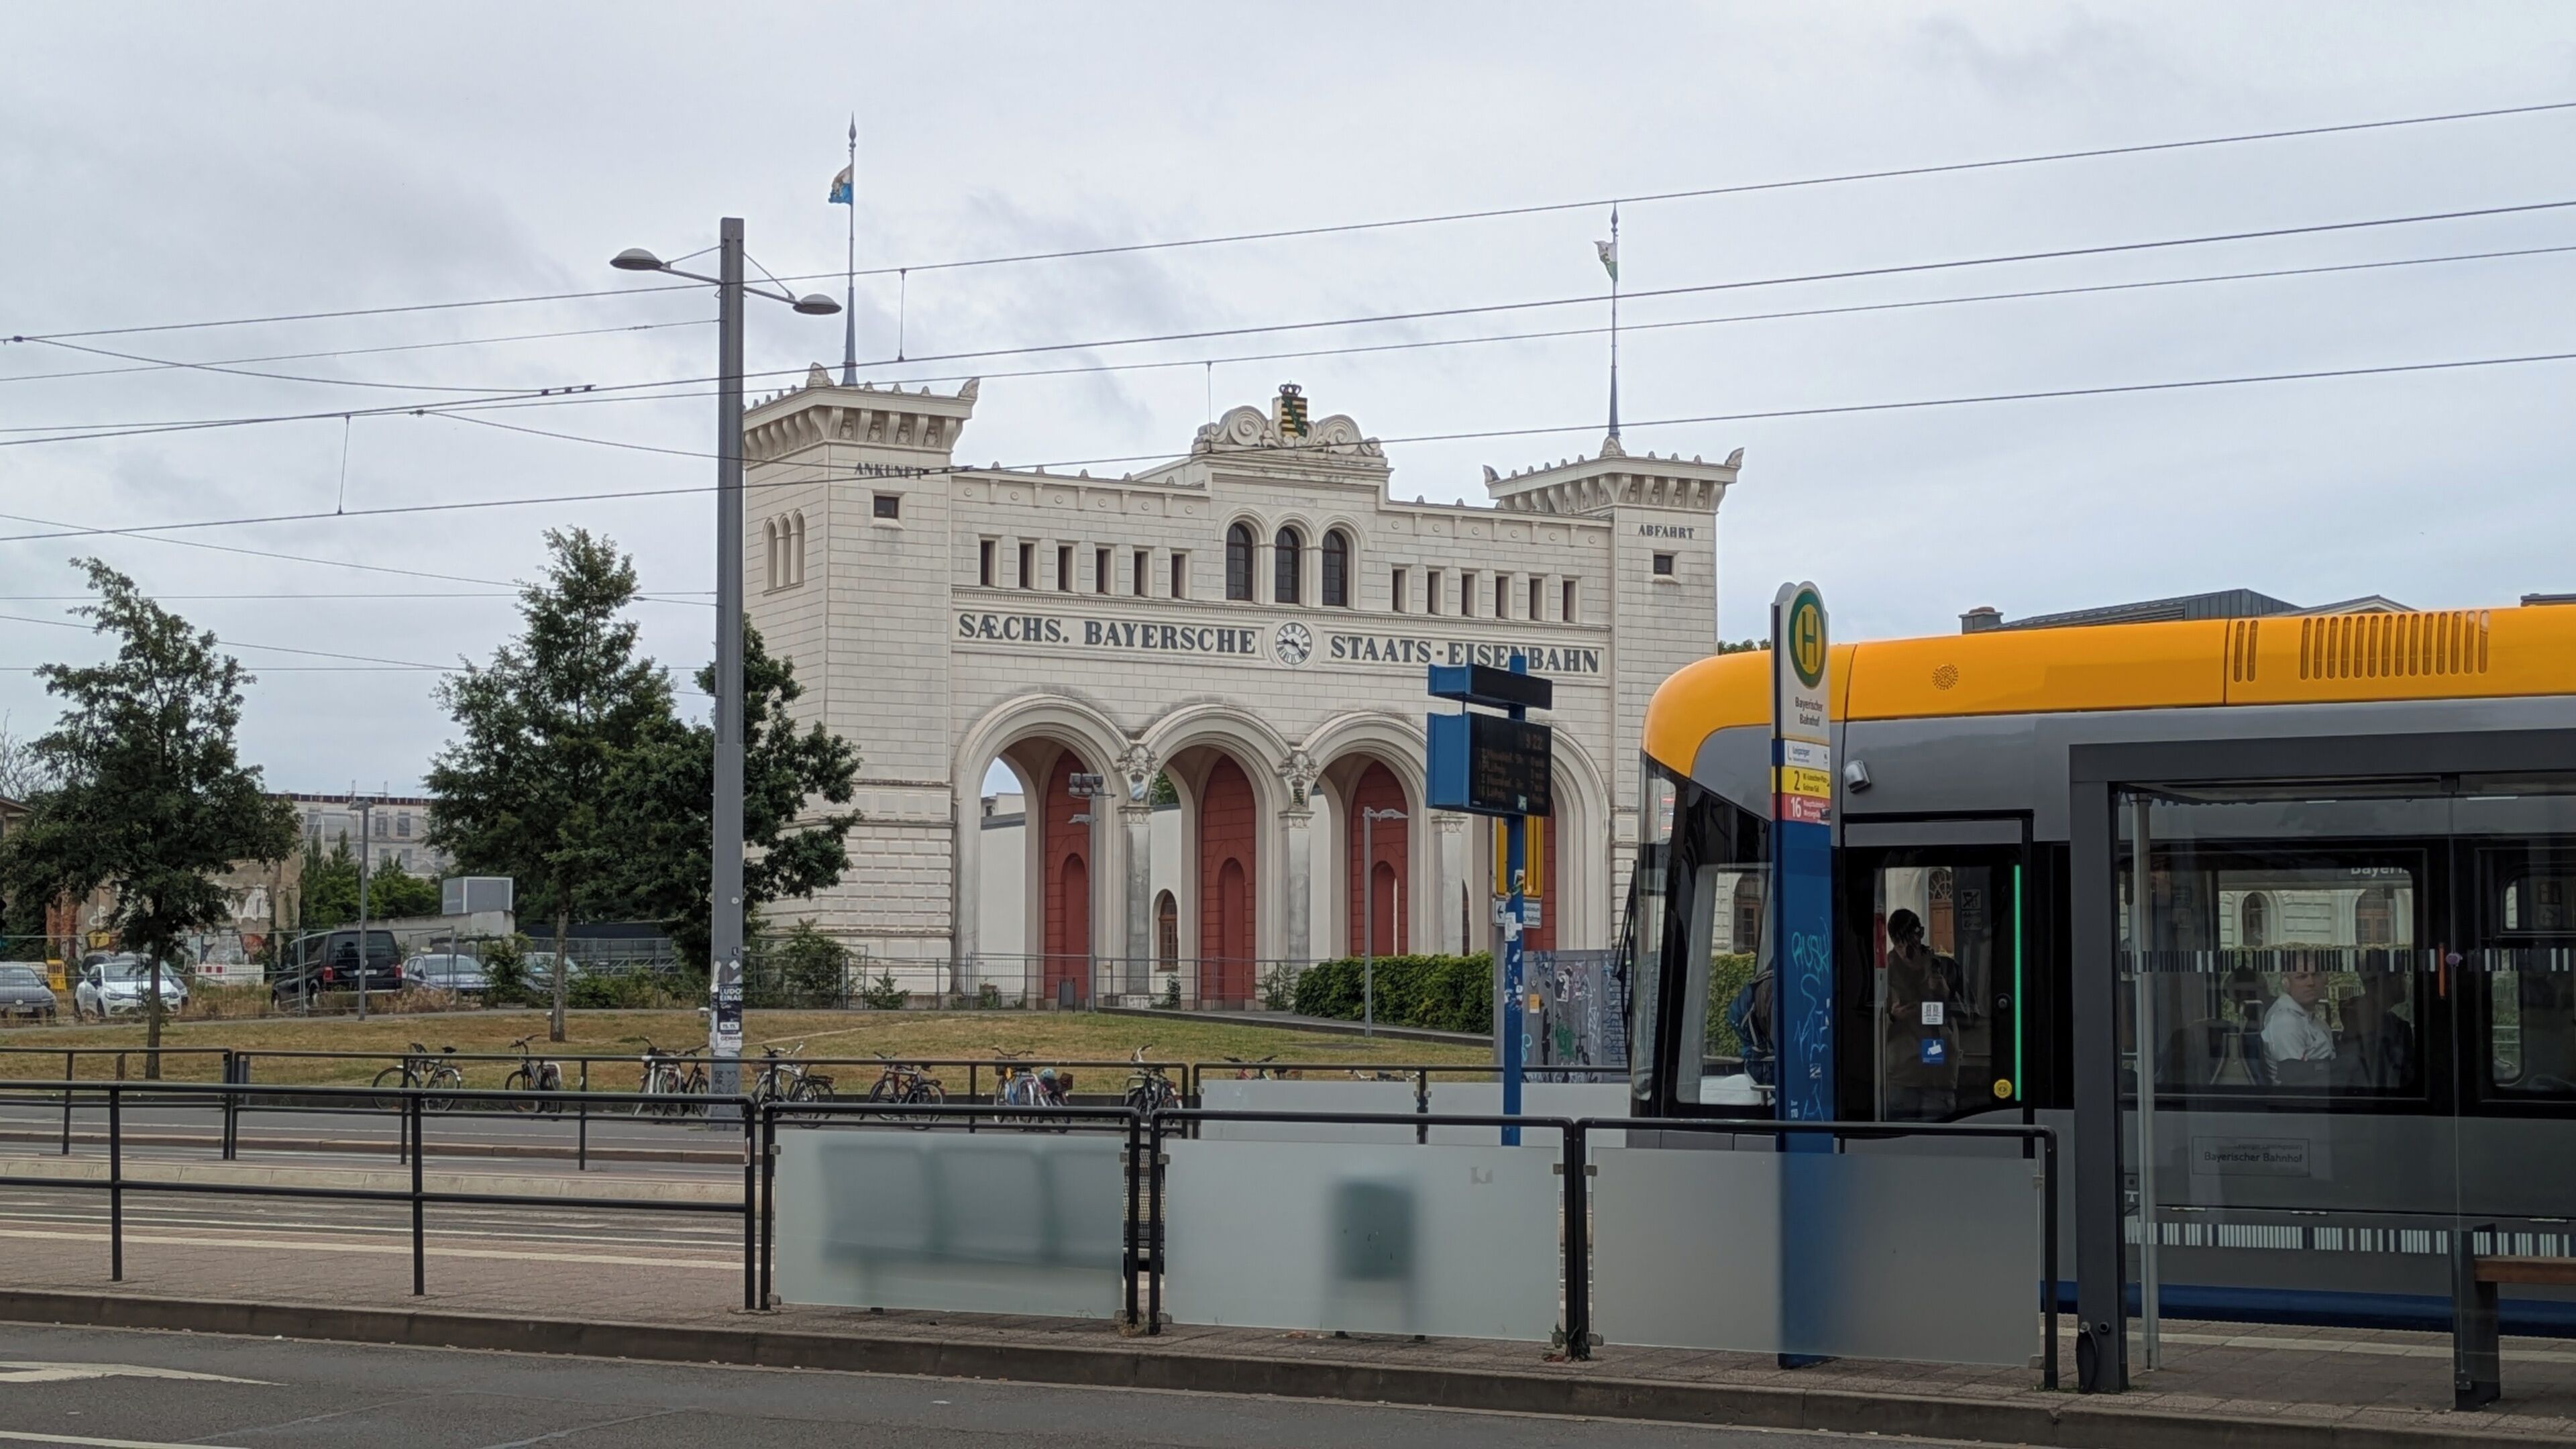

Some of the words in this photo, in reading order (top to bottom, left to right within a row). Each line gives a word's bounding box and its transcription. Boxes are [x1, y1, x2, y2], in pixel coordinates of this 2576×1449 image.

[1638, 525, 1695, 539] ABFAHRT
[959, 613, 1069, 644] SÆCHS.
[1084, 621, 1256, 653] BAYERSCHE
[1802, 611, 1817, 667] H
[1795, 696, 1823, 712] Bayerischer
[1800, 713, 1819, 727] Bahnhof
[1794, 770, 1801, 792] 2
[1790, 796, 1802, 818] 16
[2204, 1151, 2260, 1163] Bayerischer
[2263, 1152, 2303, 1163] Bahnhof
